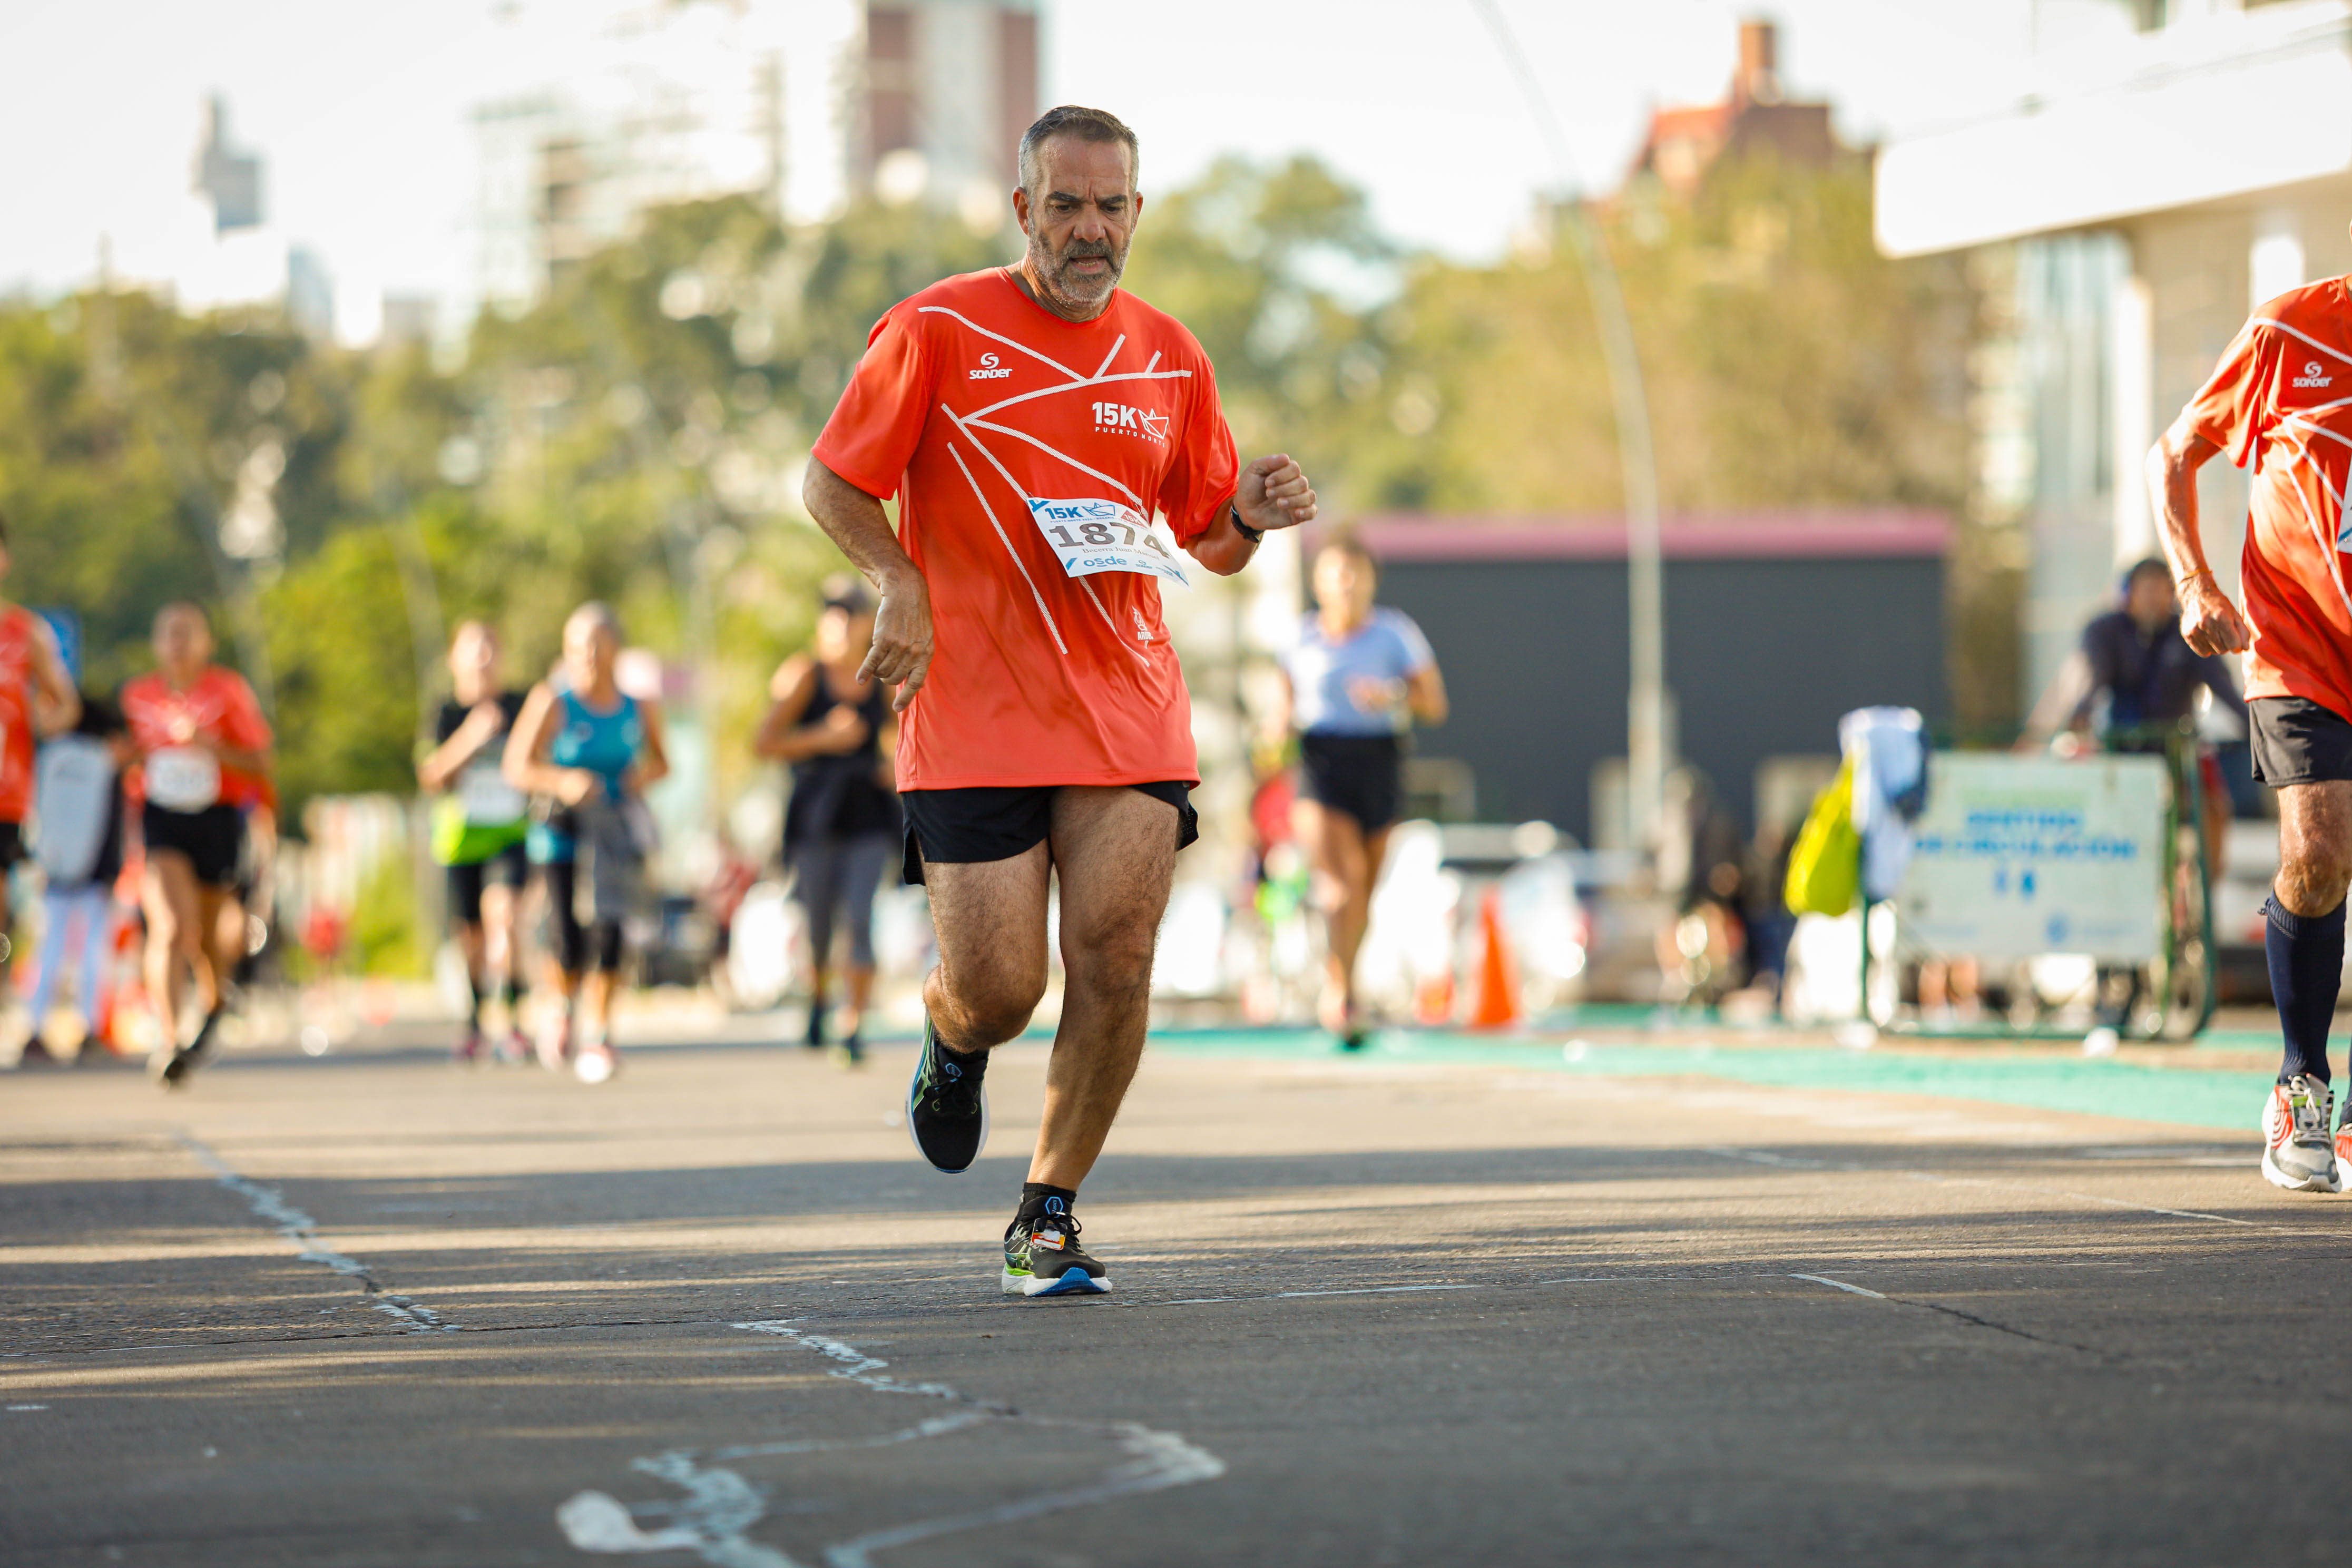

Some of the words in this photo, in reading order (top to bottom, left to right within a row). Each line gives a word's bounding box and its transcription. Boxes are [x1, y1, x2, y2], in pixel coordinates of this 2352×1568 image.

[1092, 401, 1138, 429] 15K
[1095, 427, 1138, 437] PUERTO
[1141, 434, 1165, 448] NORTE
[1045, 506, 1084, 519] 15K
[1049, 522, 1170, 558] 1874
[1083, 556, 1128, 567] osde
